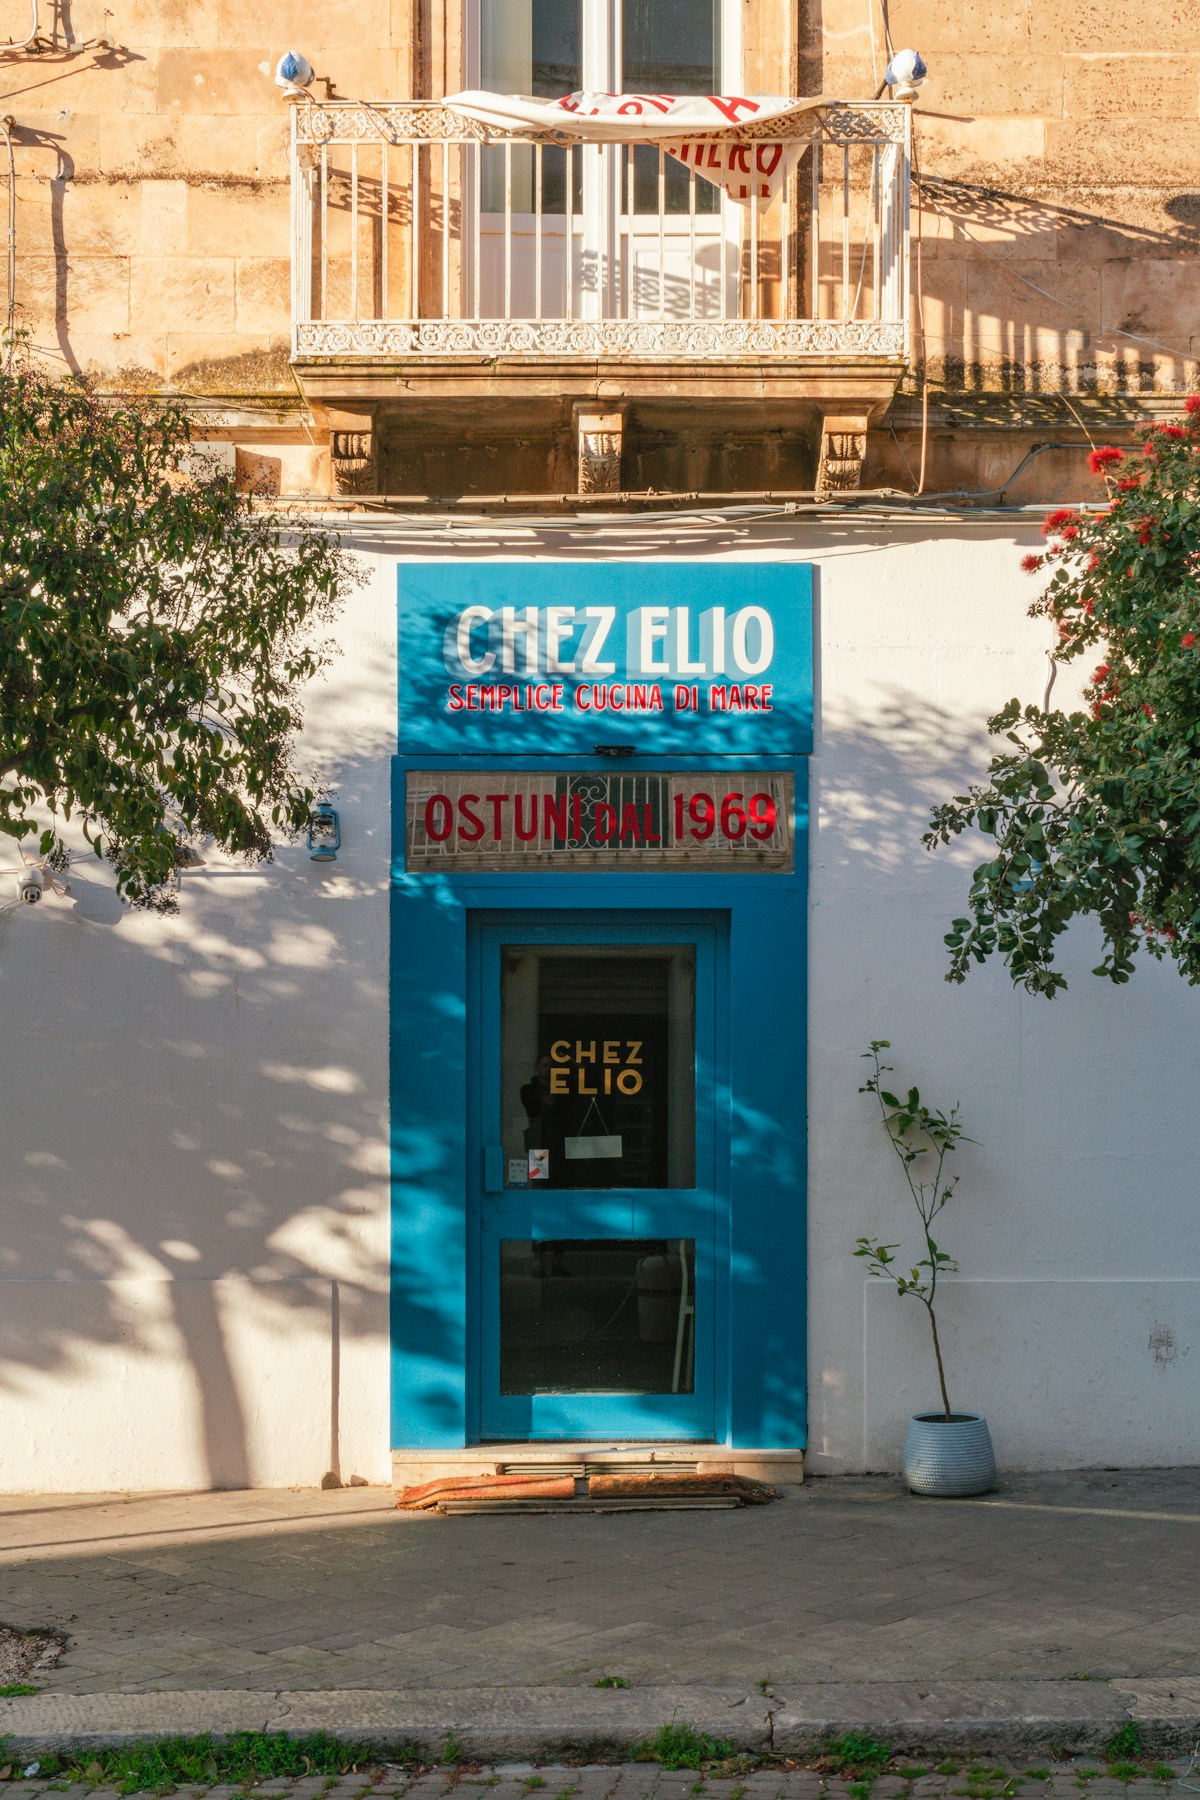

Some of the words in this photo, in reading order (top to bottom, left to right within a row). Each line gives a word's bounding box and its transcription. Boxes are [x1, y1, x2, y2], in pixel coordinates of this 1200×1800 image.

[455, 605, 616, 675] CHEZ
[639, 605, 775, 675] ELIO
[449, 683, 564, 711] SEMPLICE
[575, 684, 664, 712] CUCINA
[675, 685, 699, 711] DI
[711, 684, 773, 711] MARE
[424, 794, 582, 842] OSTUNI
[594, 802, 662, 841] DAL
[673, 791, 777, 841] 1969
[550, 1040, 644, 1065] CHEZ
[550, 1067, 644, 1096] ELIO
